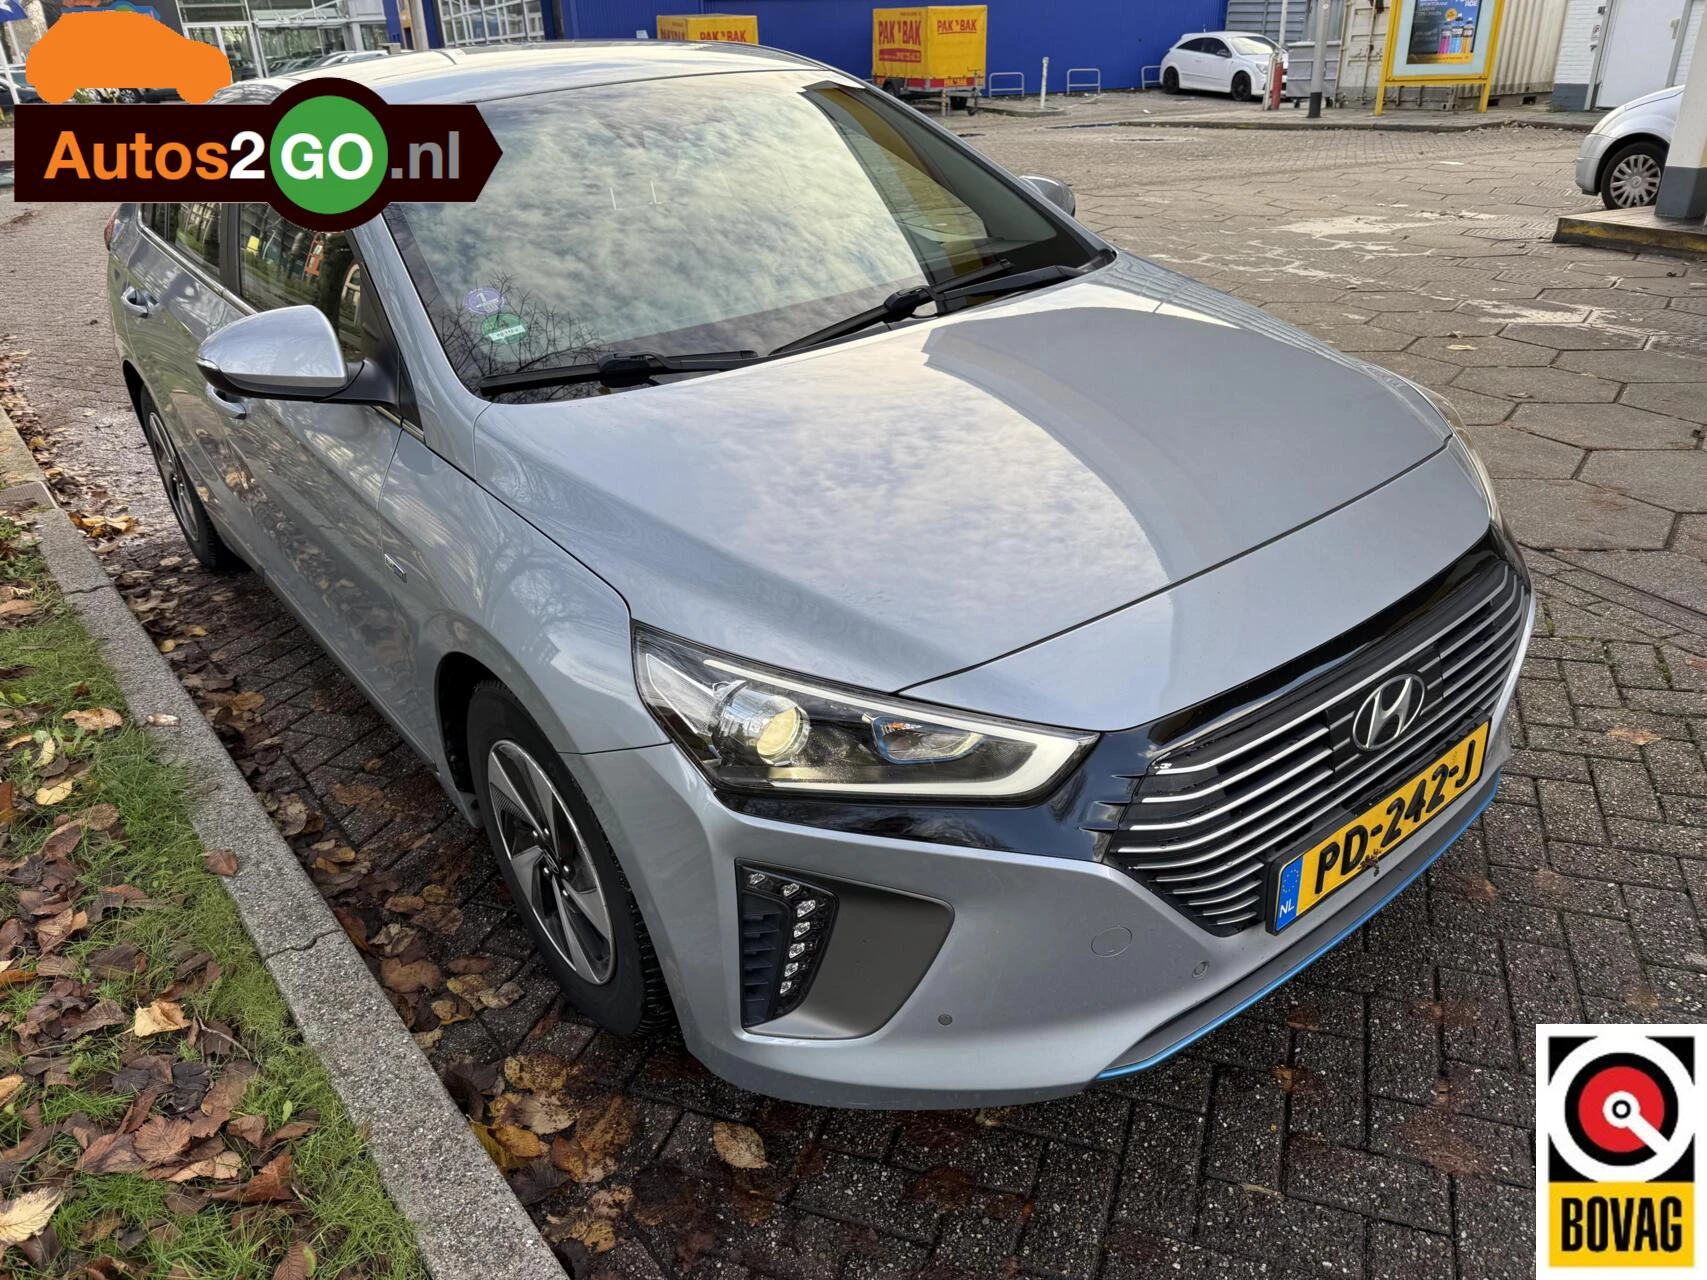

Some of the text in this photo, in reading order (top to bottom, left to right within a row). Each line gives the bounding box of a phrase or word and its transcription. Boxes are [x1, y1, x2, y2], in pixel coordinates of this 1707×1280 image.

[726, 30, 747, 42] BAK
[878, 20, 895, 46] PAK
[902, 20, 921, 46] BAK
[936, 19, 954, 32] PAK
[959, 19, 977, 32] BAK
[1314, 739, 1476, 895] PD-242-J
[1279, 897, 1295, 918] NL
